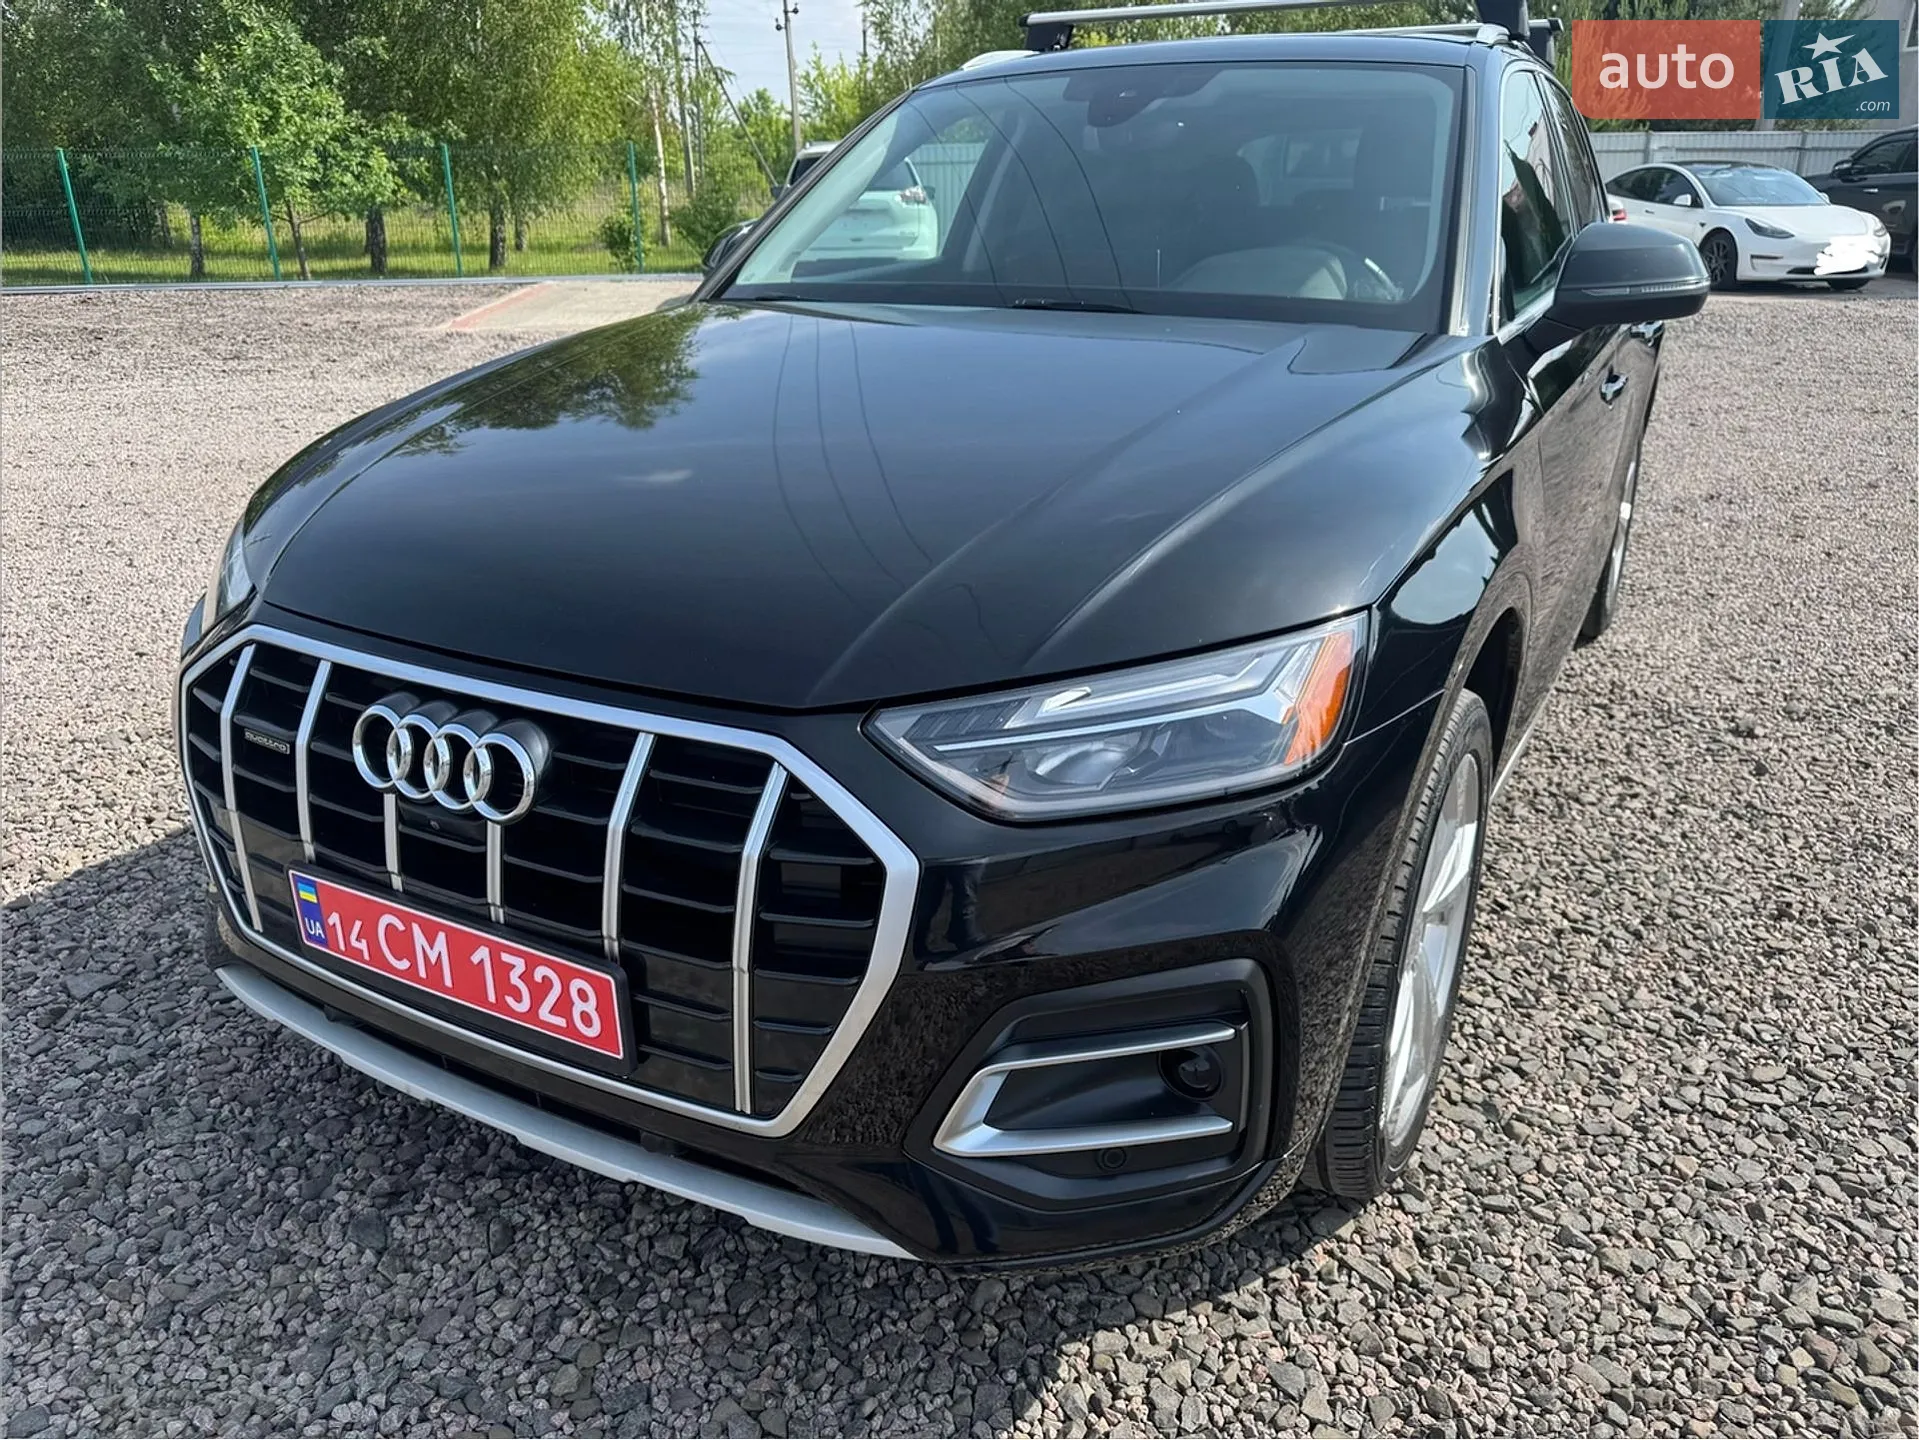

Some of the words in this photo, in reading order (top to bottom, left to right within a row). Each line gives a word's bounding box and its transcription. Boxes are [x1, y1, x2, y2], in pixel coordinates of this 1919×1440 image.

[305, 917, 326, 939] UA
[327, 911, 370, 962] 14
[376, 913, 453, 988] CM
[470, 945, 602, 1039] 1328
